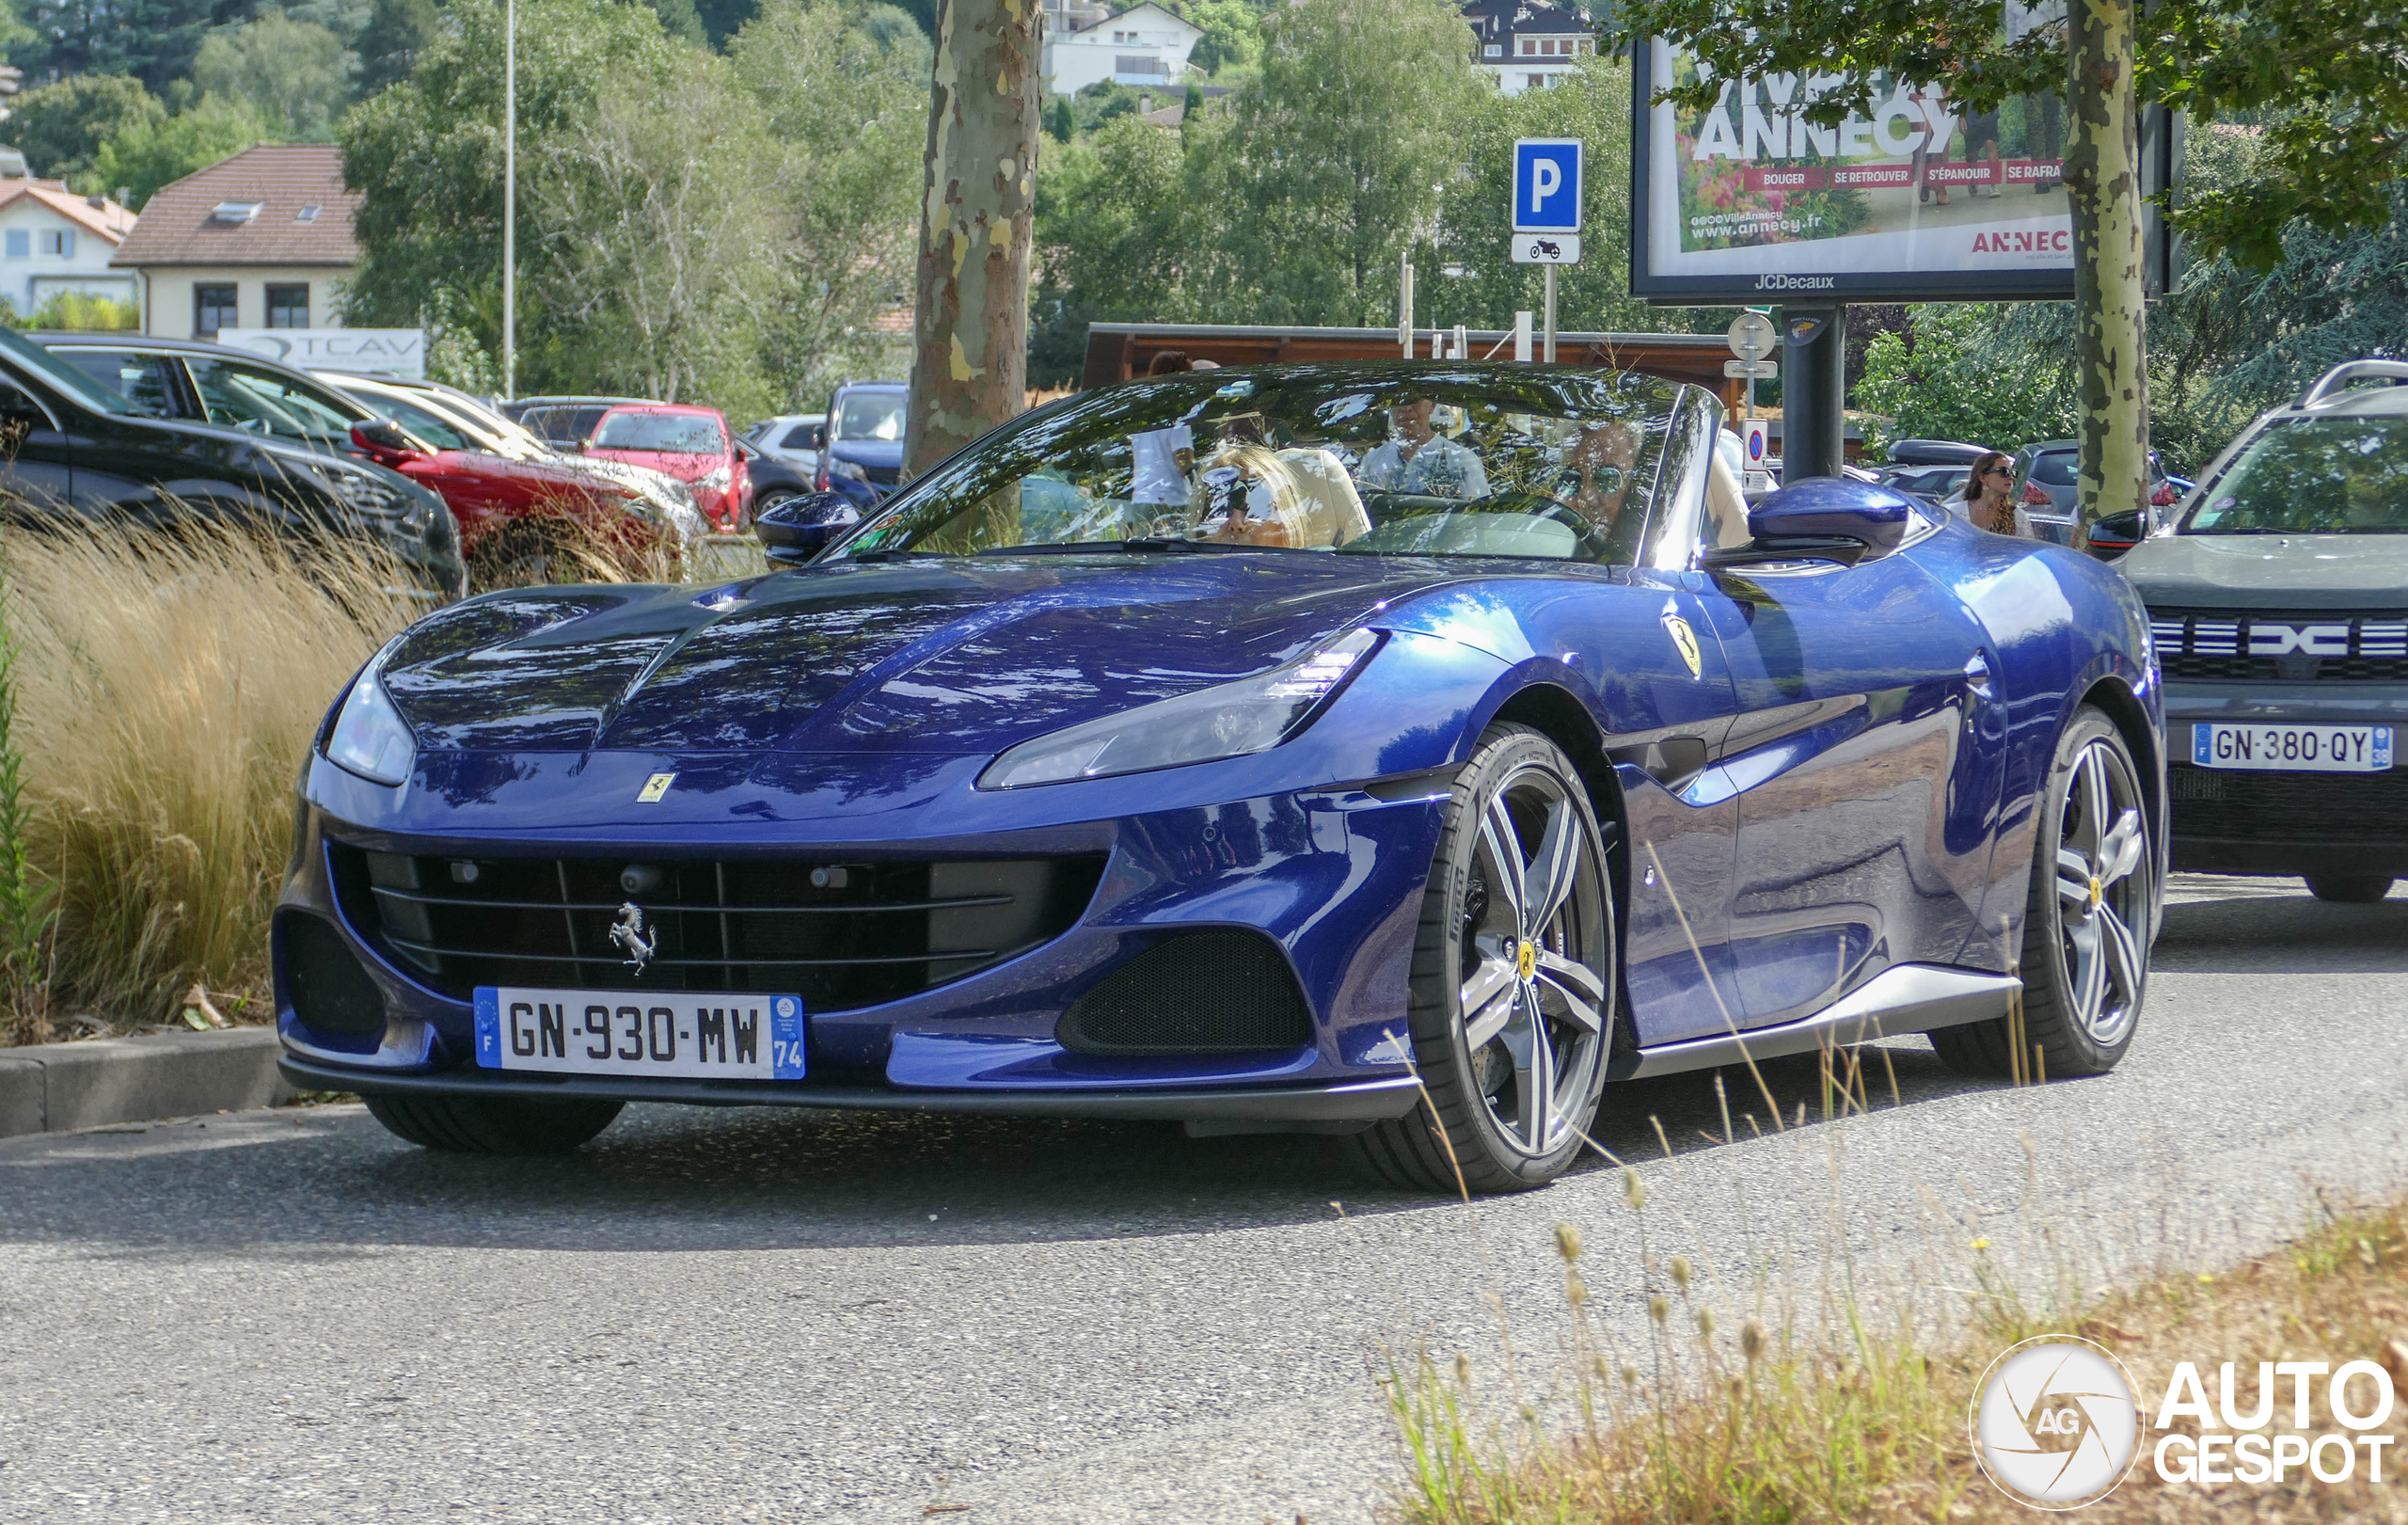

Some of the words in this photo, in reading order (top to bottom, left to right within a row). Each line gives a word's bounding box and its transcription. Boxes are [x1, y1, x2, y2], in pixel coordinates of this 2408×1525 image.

[1692, 99, 1961, 160] ANNECY
[1764, 173, 1805, 185] BOUGER
[1834, 172, 1847, 183] SE
[1849, 170, 1909, 183] RETROUVER
[1929, 167, 1991, 181] S'ÉPANOUIR
[2008, 166, 2022, 179] SE
[2023, 163, 2063, 178] RAFRA
[1532, 158, 1561, 213] P
[1723, 211, 1782, 223] VilleAnnecy
[1691, 214, 1822, 239] www.annecy.fr
[1972, 230, 2072, 253] ANNEC
[1755, 274, 1834, 290] JCDecaux
[296, 337, 419, 356] TCAV
[2199, 747, 2206, 756] F
[2216, 730, 2368, 763] GN-380-QY
[2372, 749, 2389, 763] 38
[509, 1002, 758, 1064] GN-930-MW
[483, 1036, 492, 1052] F
[773, 1040, 802, 1068] 74
